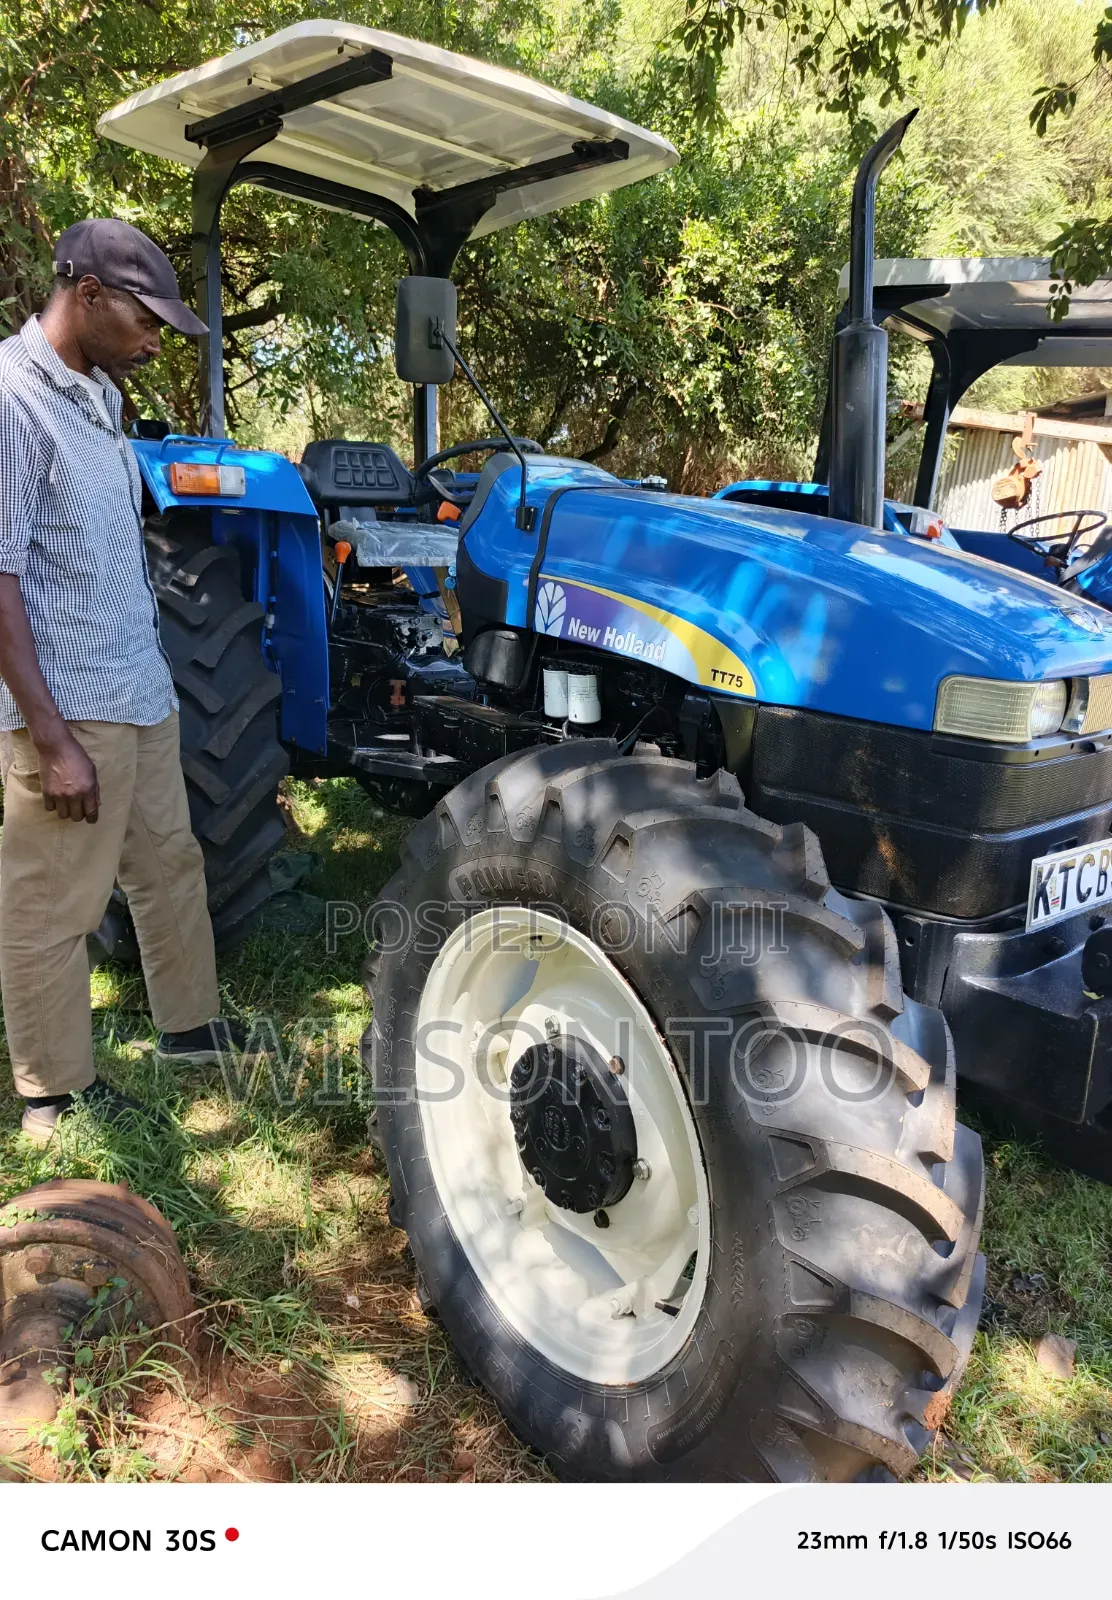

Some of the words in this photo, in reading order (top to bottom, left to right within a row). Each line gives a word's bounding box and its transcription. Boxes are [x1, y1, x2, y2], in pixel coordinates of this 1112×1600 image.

[567, 617, 600, 643] New
[602, 626, 667, 662] Holland
[710, 668, 744, 688] TT75
[1032, 849, 1112, 920] KTCB
